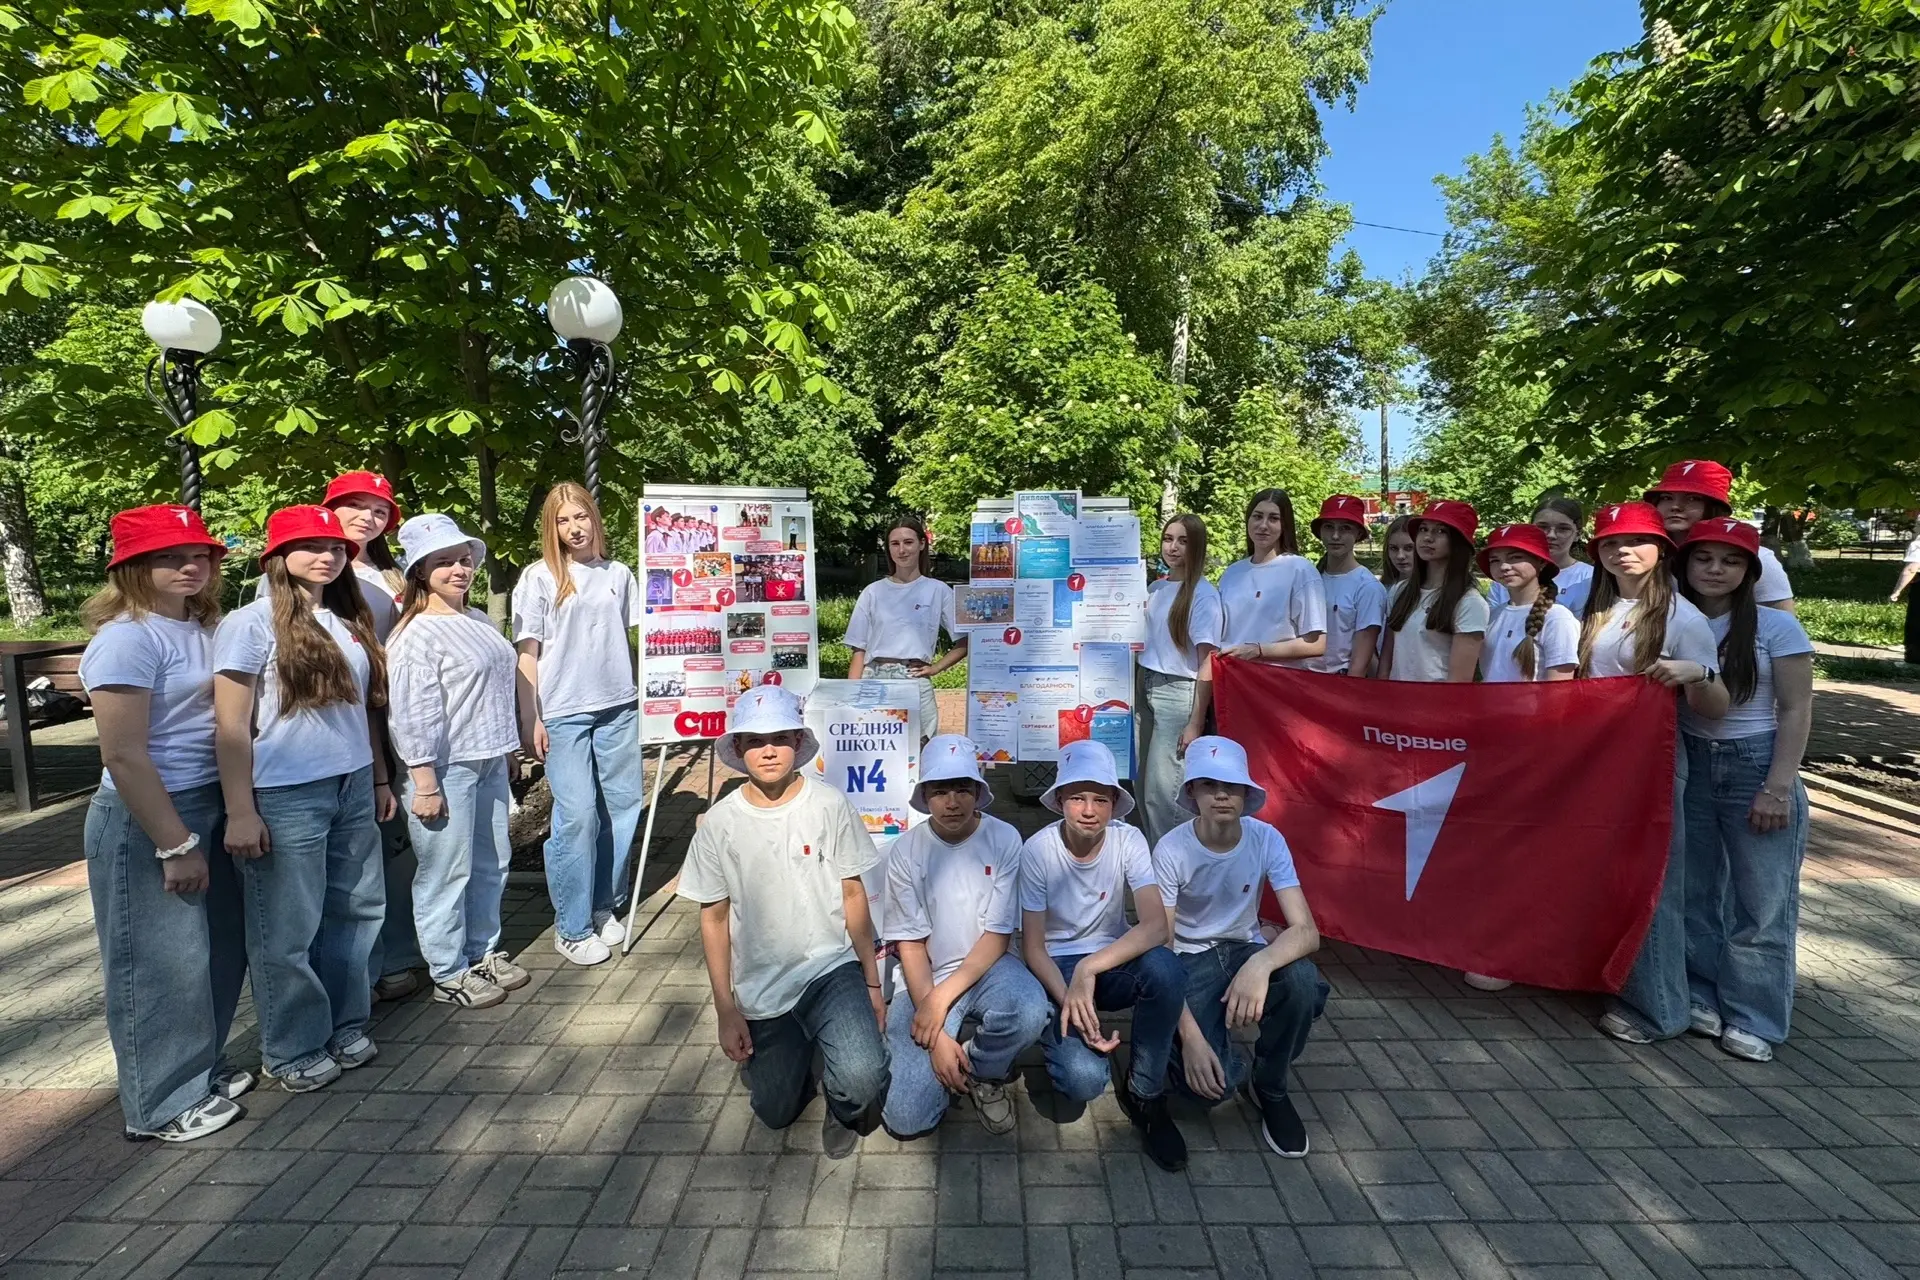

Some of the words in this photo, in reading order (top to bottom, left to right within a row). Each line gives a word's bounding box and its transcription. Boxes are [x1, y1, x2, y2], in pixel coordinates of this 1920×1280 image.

[673, 710, 727, 738] СШ
[828, 721, 904, 738] СРЕДНЯЯ
[835, 738, 897, 752] ШКОЛА
[1363, 725, 1468, 752] Первые
